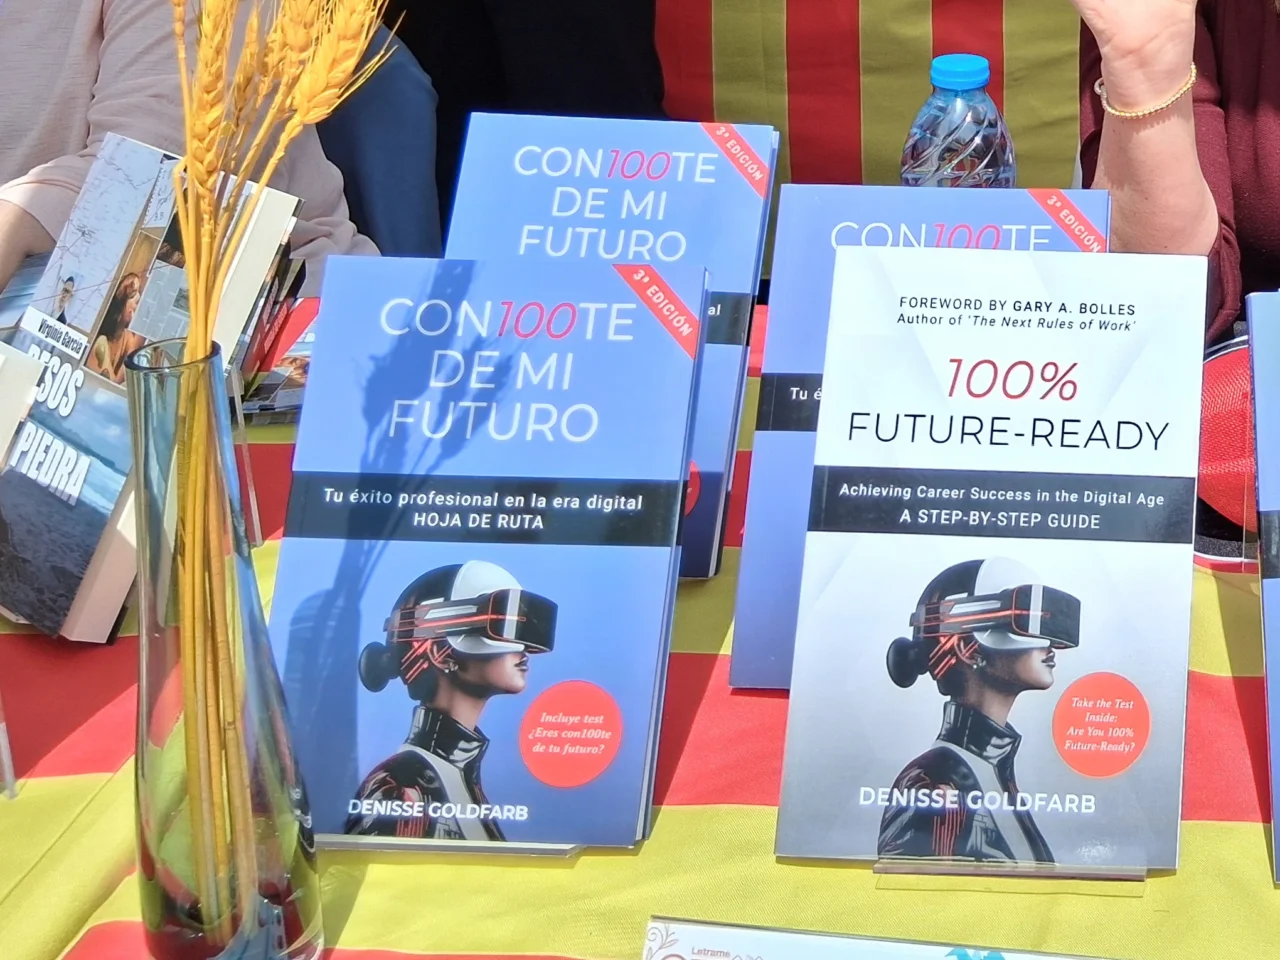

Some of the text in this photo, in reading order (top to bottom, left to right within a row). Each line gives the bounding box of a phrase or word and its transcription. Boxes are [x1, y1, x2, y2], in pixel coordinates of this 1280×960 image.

[514, 145, 719, 183] CON100TE
[725, 138, 764, 182] EDICIÓN
[551, 186, 667, 221] DE MI
[518, 224, 687, 262] FUTURO
[1058, 208, 1101, 252] EDICIÓN
[380, 297, 637, 342] CON100TE
[644, 285, 692, 338] EDICIÓN
[897, 314, 942, 326] Author
[947, 314, 963, 326] of
[1001, 316, 1032, 329] Next
[1037, 317, 1074, 330] Rules
[1079, 318, 1094, 331] of
[900, 296, 1135, 316] FOREWORD BY GARY A. BOLLES
[38, 318, 84, 355] Virginia García
[429, 349, 574, 391] DE MI
[947, 357, 1079, 402] 100%
[388, 400, 599, 442] FUTURO
[848, 412, 1170, 452] FUTURE-READY
[10, 421, 91, 506] PIEDRA
[839, 483, 1164, 508] Achieving Career Success in the Digital Age
[900, 509, 1101, 529] A STEP-BY-STEP GUIDE
[1072, 697, 1134, 709] Take the Test
[1085, 712, 1118, 724] Inside:
[1064, 740, 1135, 754] Future-Ready?
[1067, 726, 1134, 738] Are You 100%
[348, 798, 529, 821] DENISSE GOLDFARB
[859, 786, 1096, 814] DENISSE GOLDFARB
[691, 947, 730, 958] Letrame
